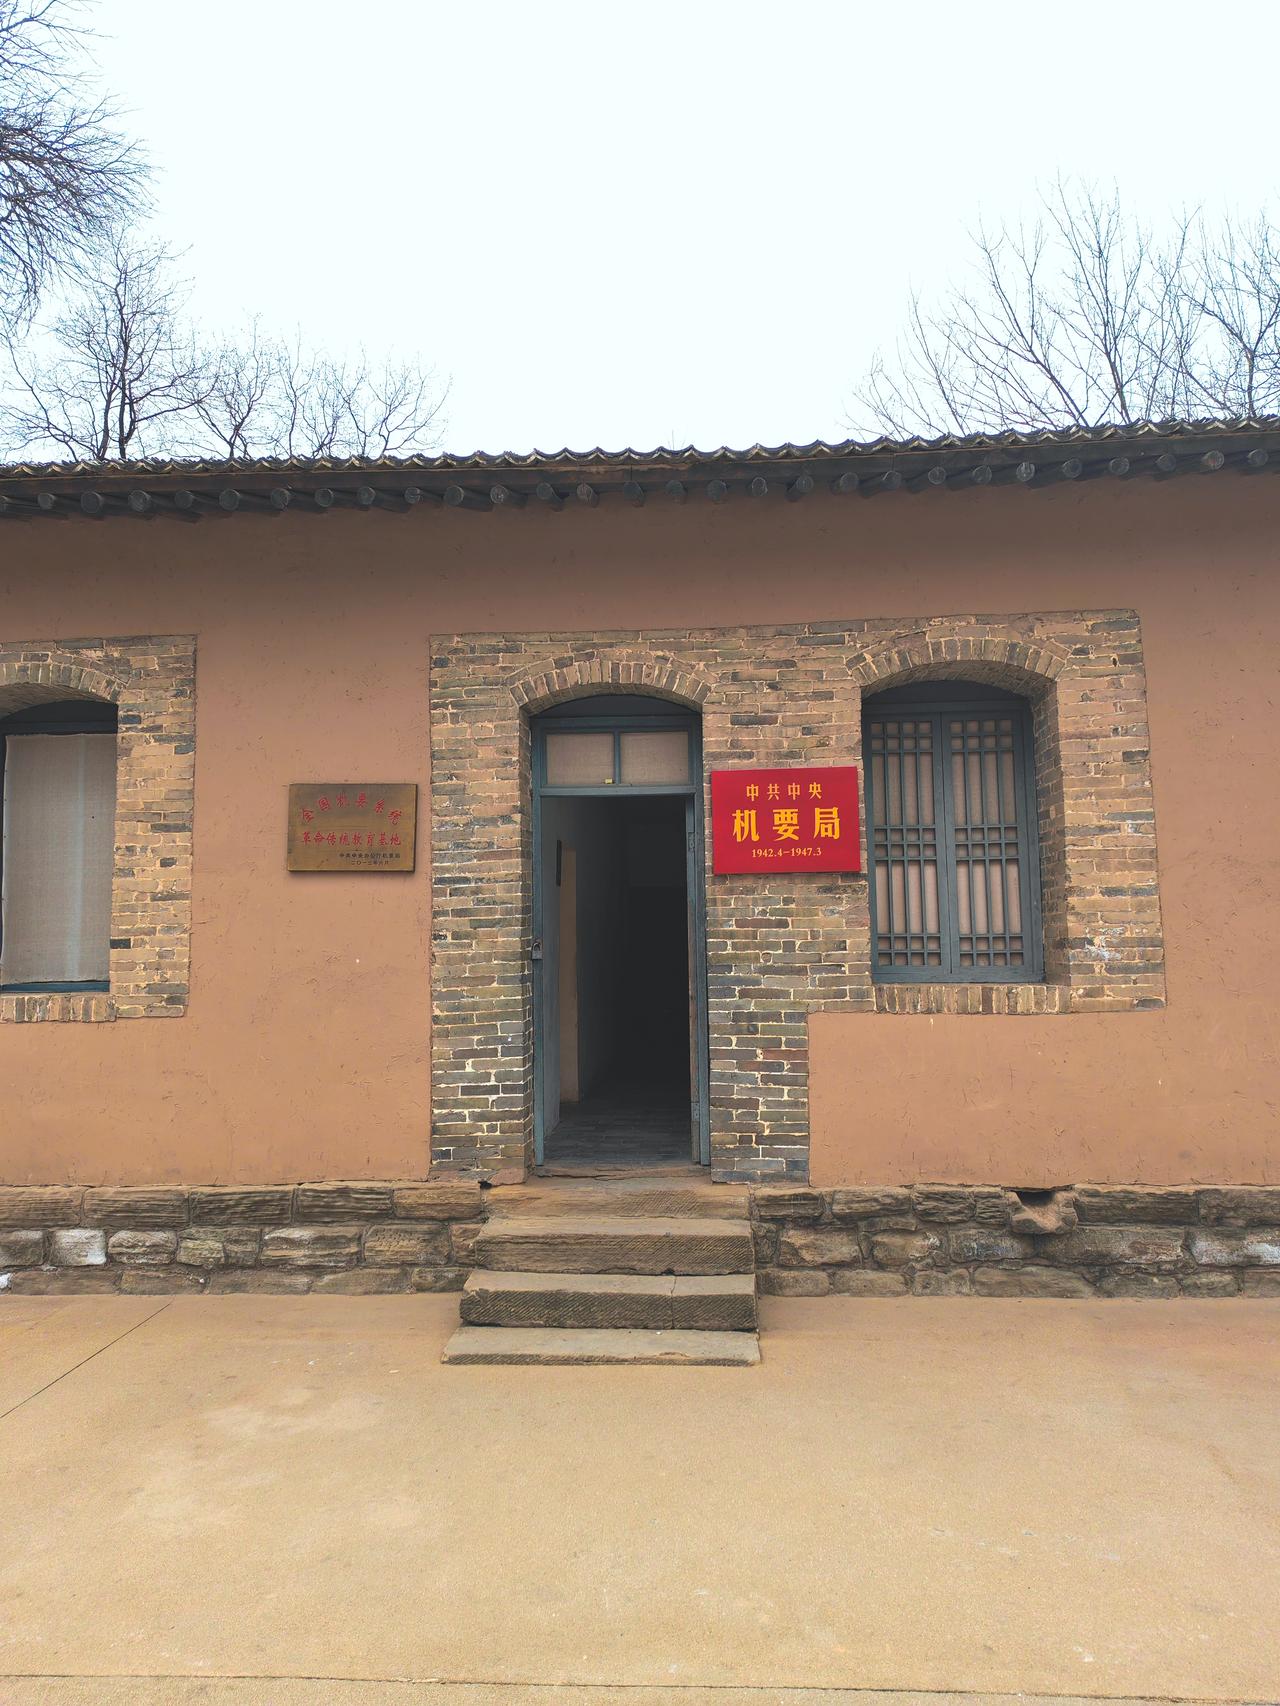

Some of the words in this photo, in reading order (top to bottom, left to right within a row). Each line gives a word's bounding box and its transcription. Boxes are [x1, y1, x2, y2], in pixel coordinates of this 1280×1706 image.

[746, 782, 822, 802] 中共中央
[732, 807, 841, 842] 机要局
[302, 831, 401, 847] 革命传统教育基地
